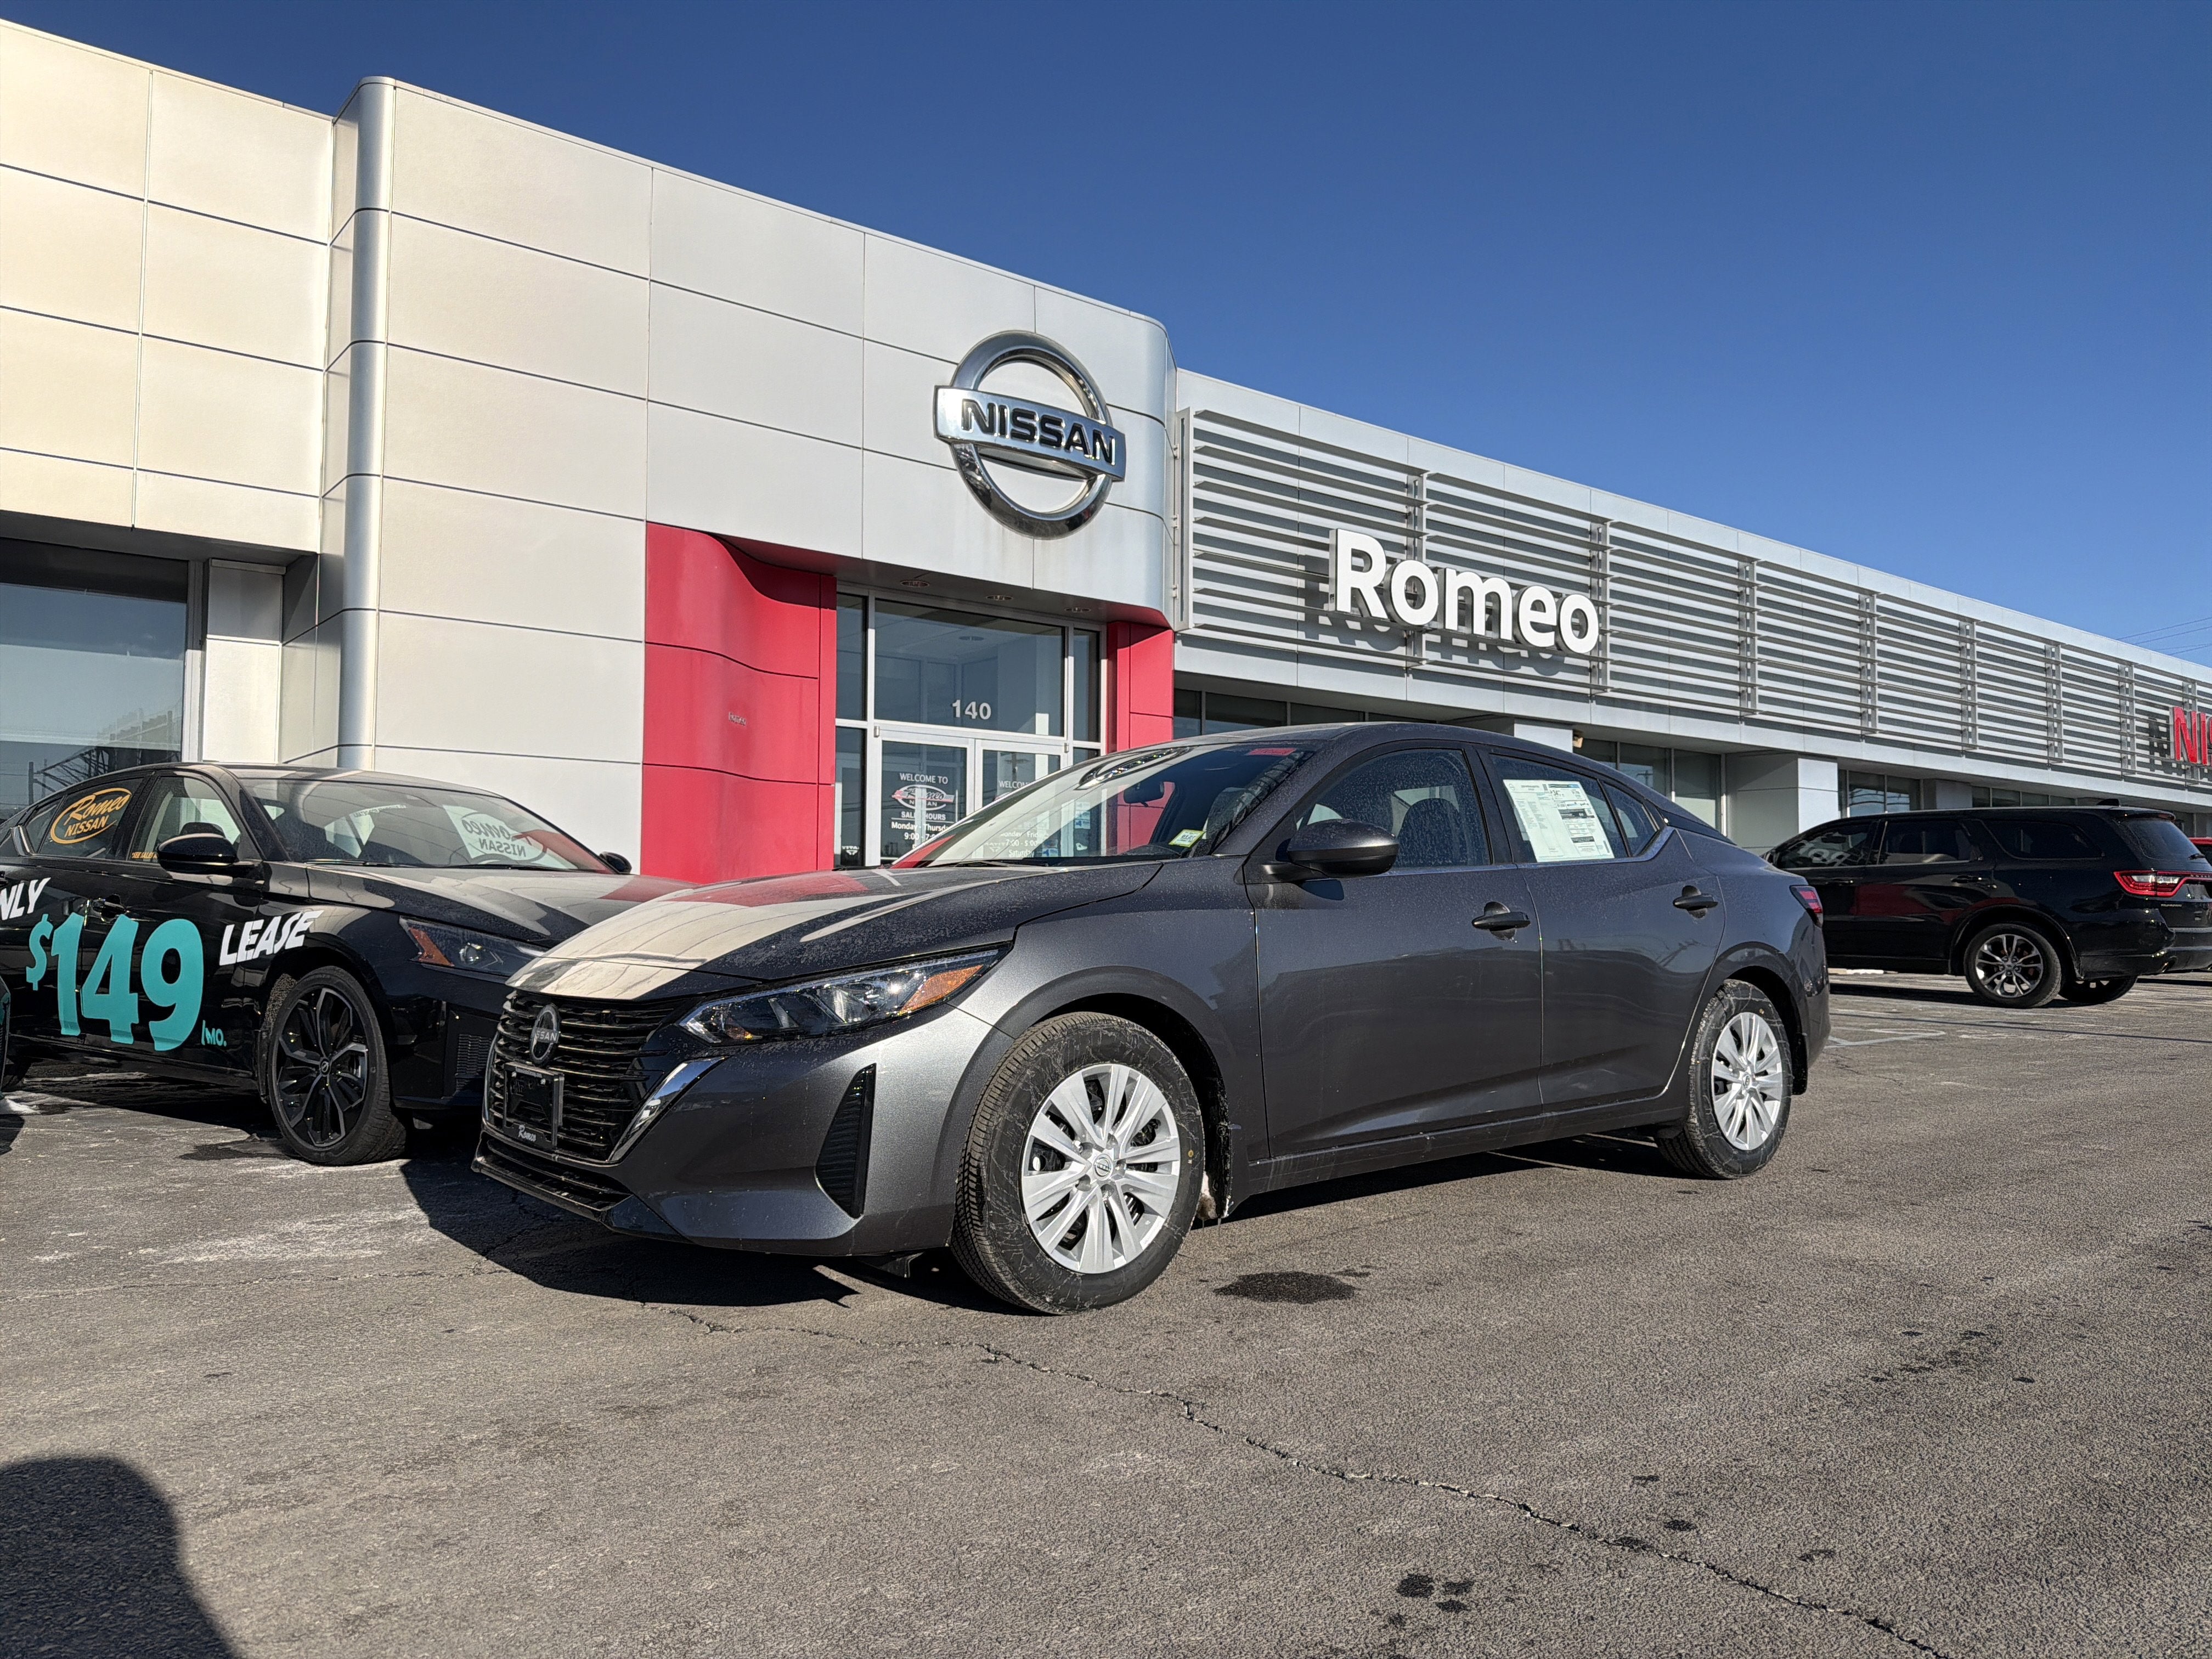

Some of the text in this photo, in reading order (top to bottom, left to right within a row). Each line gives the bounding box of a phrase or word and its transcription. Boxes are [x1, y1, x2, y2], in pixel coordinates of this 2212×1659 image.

[961, 398, 1116, 466] NISSAN
[1331, 528, 1599, 654] Romeo
[952, 699, 991, 720] 140
[2170, 706, 2212, 766] NI
[900, 772, 949, 785] WELCOME TO
[999, 780, 1030, 788] WELCO
[63, 794, 131, 825] Romeo
[901, 811, 916, 819] SAL
[64, 815, 110, 838] NISSAN
[891, 821, 918, 831] Monday
[904, 832, 920, 840] 9:00
[219, 910, 324, 966] LEASE
[26, 912, 227, 1051] $149 /MO.
